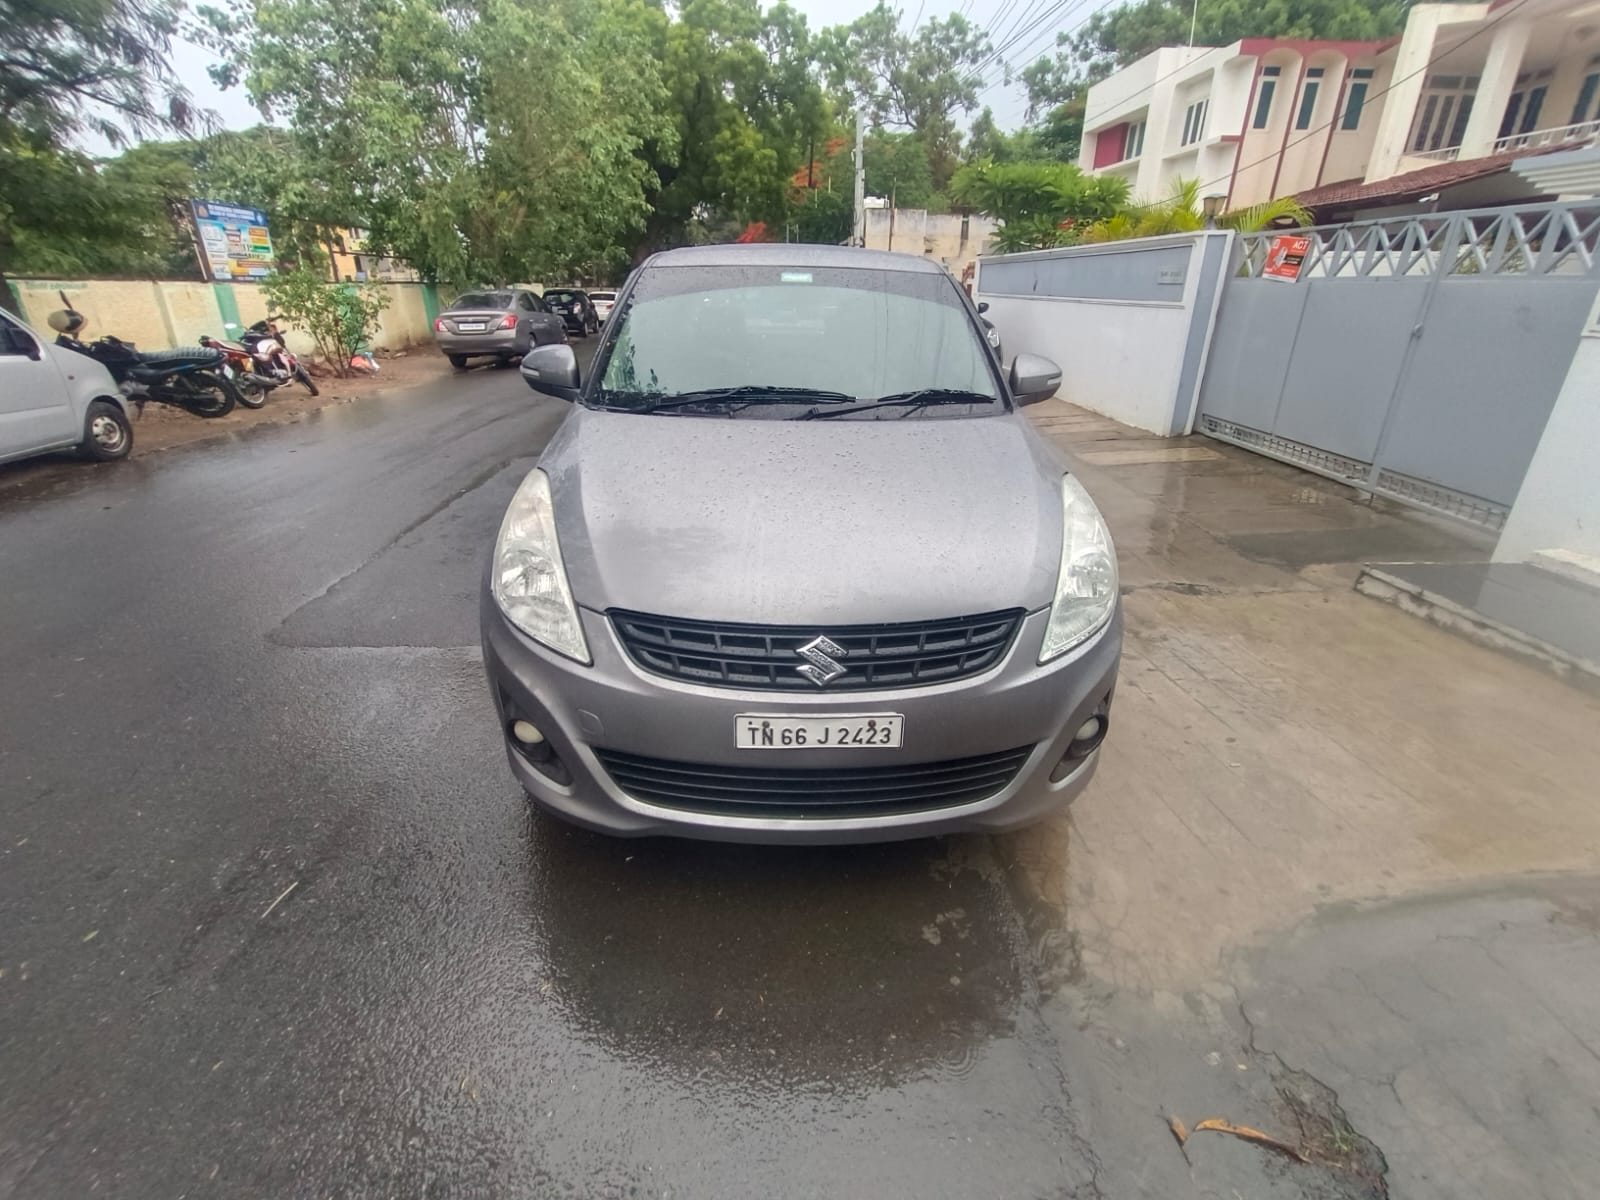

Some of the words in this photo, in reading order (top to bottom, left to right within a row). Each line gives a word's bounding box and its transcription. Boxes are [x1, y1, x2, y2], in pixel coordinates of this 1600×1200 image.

[1292, 240, 1309, 250] ACT
[747, 727, 774, 746] TN
[781, 728, 807, 746] 66
[817, 727, 829, 745] J
[837, 726, 891, 746] 2423
